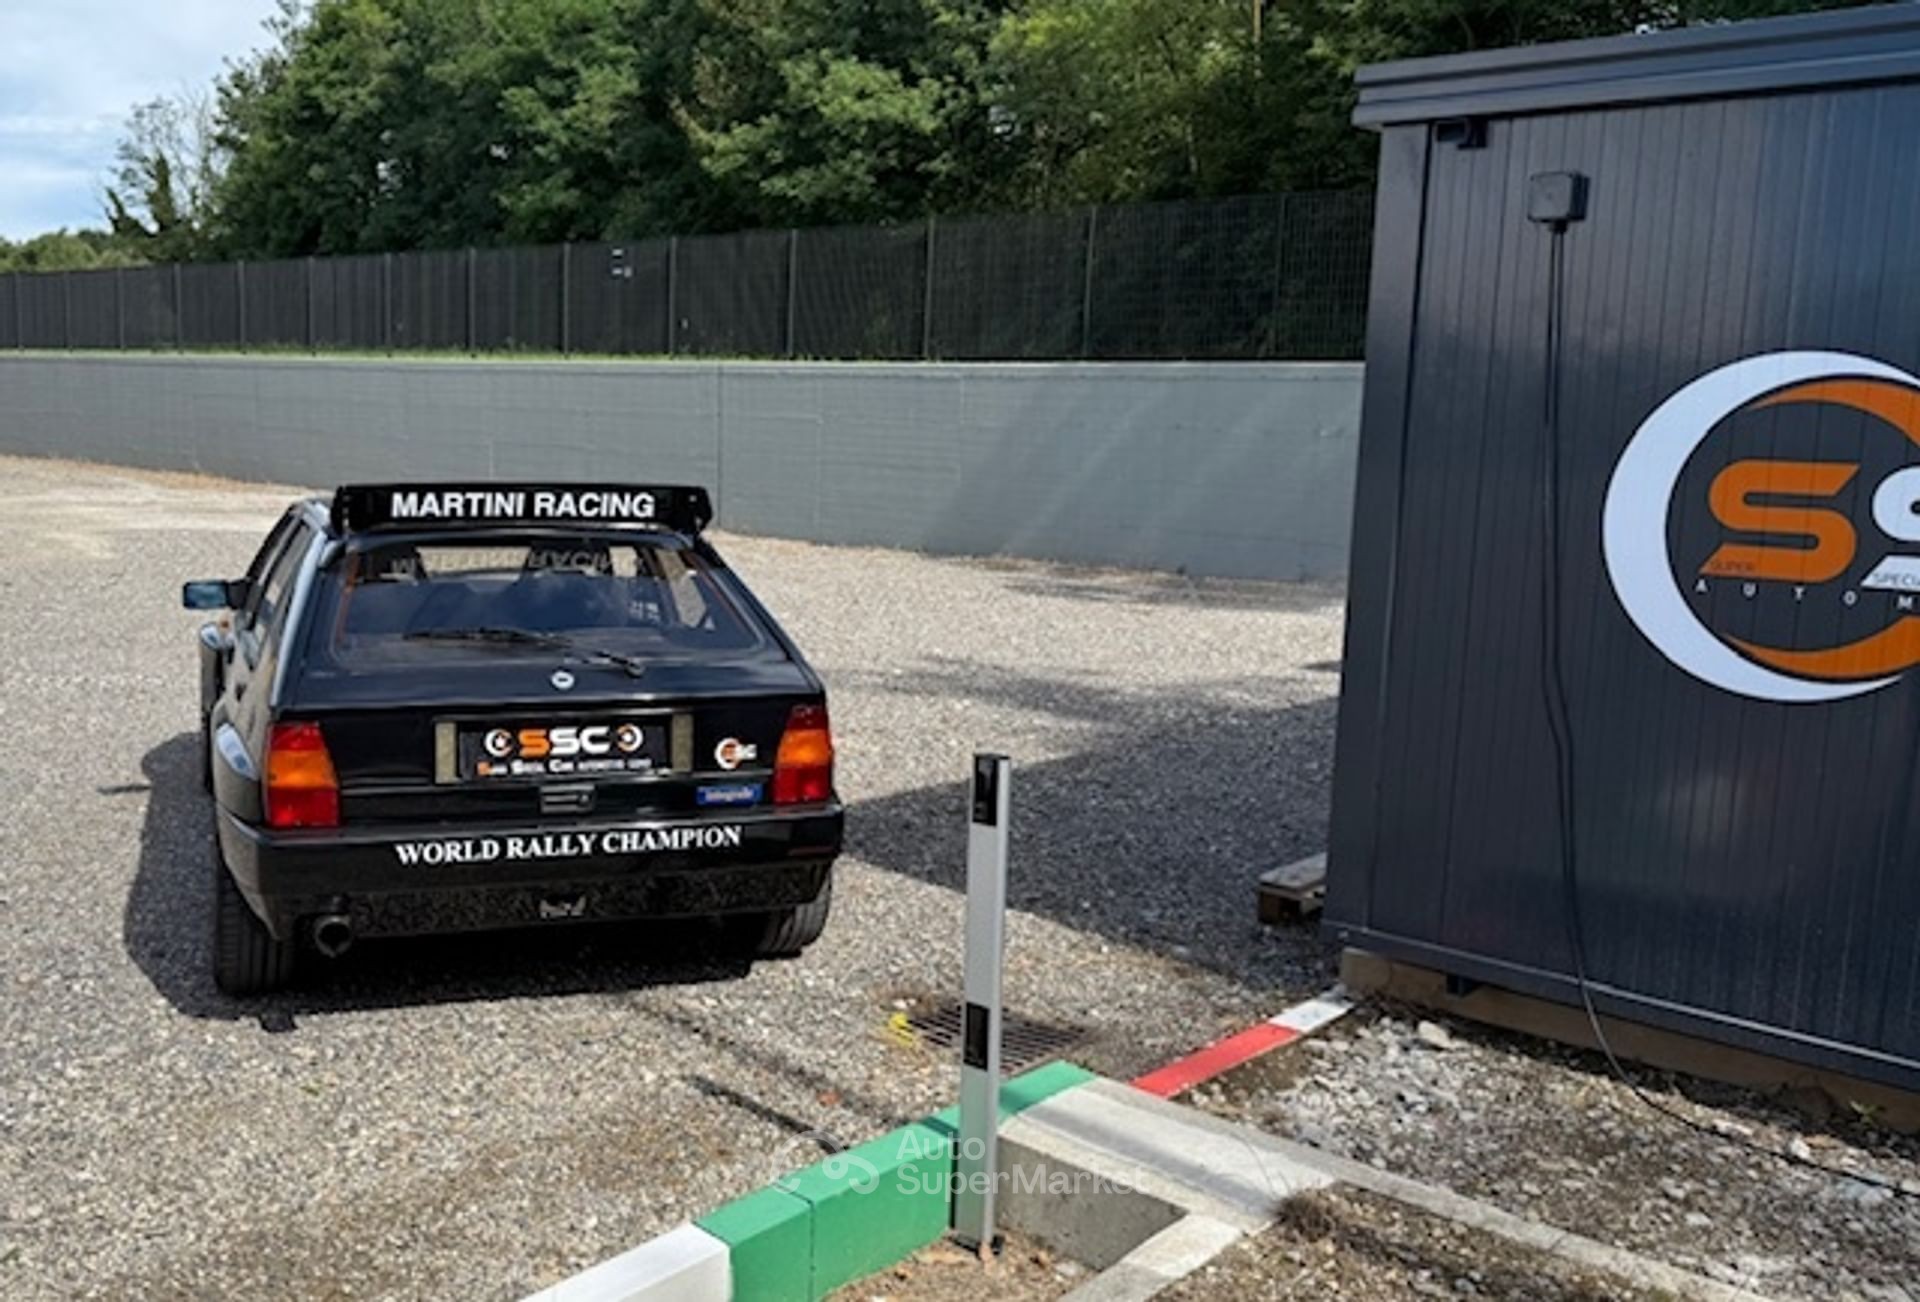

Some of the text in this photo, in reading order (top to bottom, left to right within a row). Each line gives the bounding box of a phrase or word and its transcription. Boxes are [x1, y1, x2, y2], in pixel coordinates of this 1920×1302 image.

[391, 492, 655, 518] MARTINI RACING
[518, 725, 612, 758] SSC
[395, 824, 743, 866] WORLD RALLY CHAMPION
